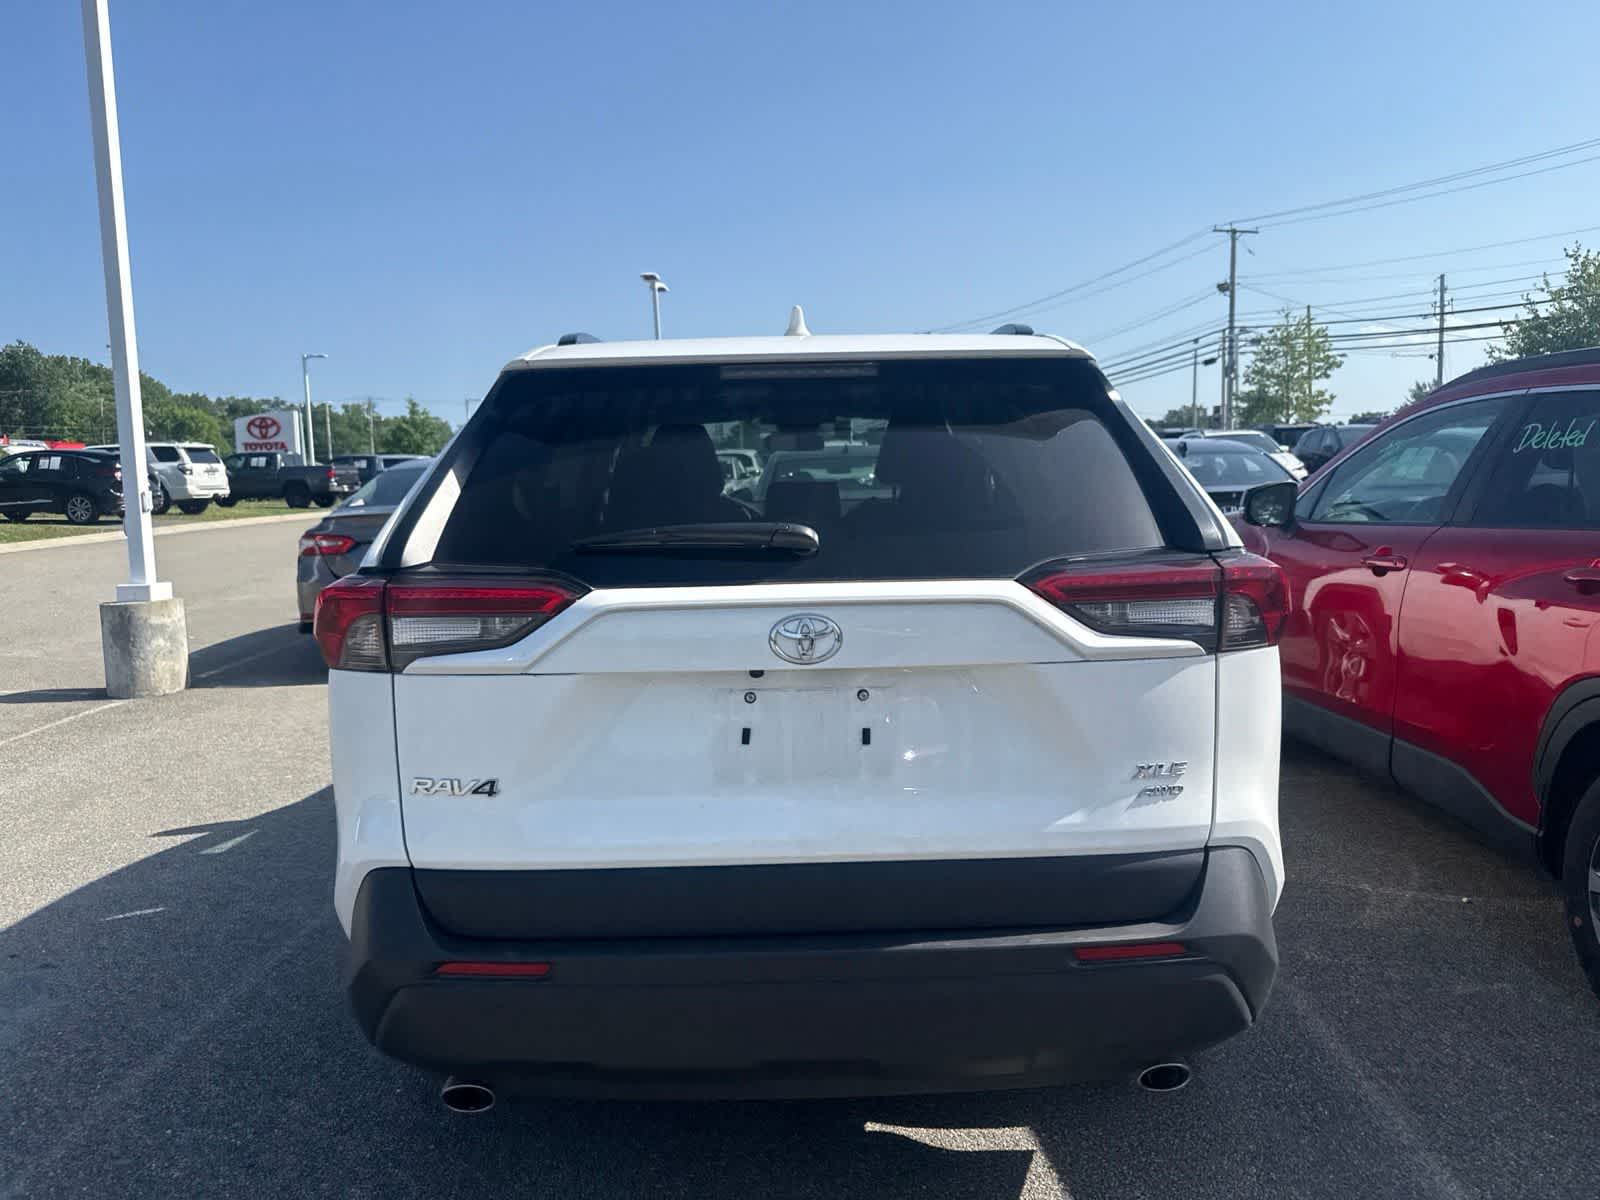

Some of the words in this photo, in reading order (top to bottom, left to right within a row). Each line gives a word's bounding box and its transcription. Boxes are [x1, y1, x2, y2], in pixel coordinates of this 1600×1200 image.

[1513, 418, 1596, 453] Deleted
[243, 441, 288, 452] TOYOTA
[1134, 761, 1188, 778] XLE
[411, 777, 499, 797] RAV4
[1138, 785, 1184, 799] AWD
